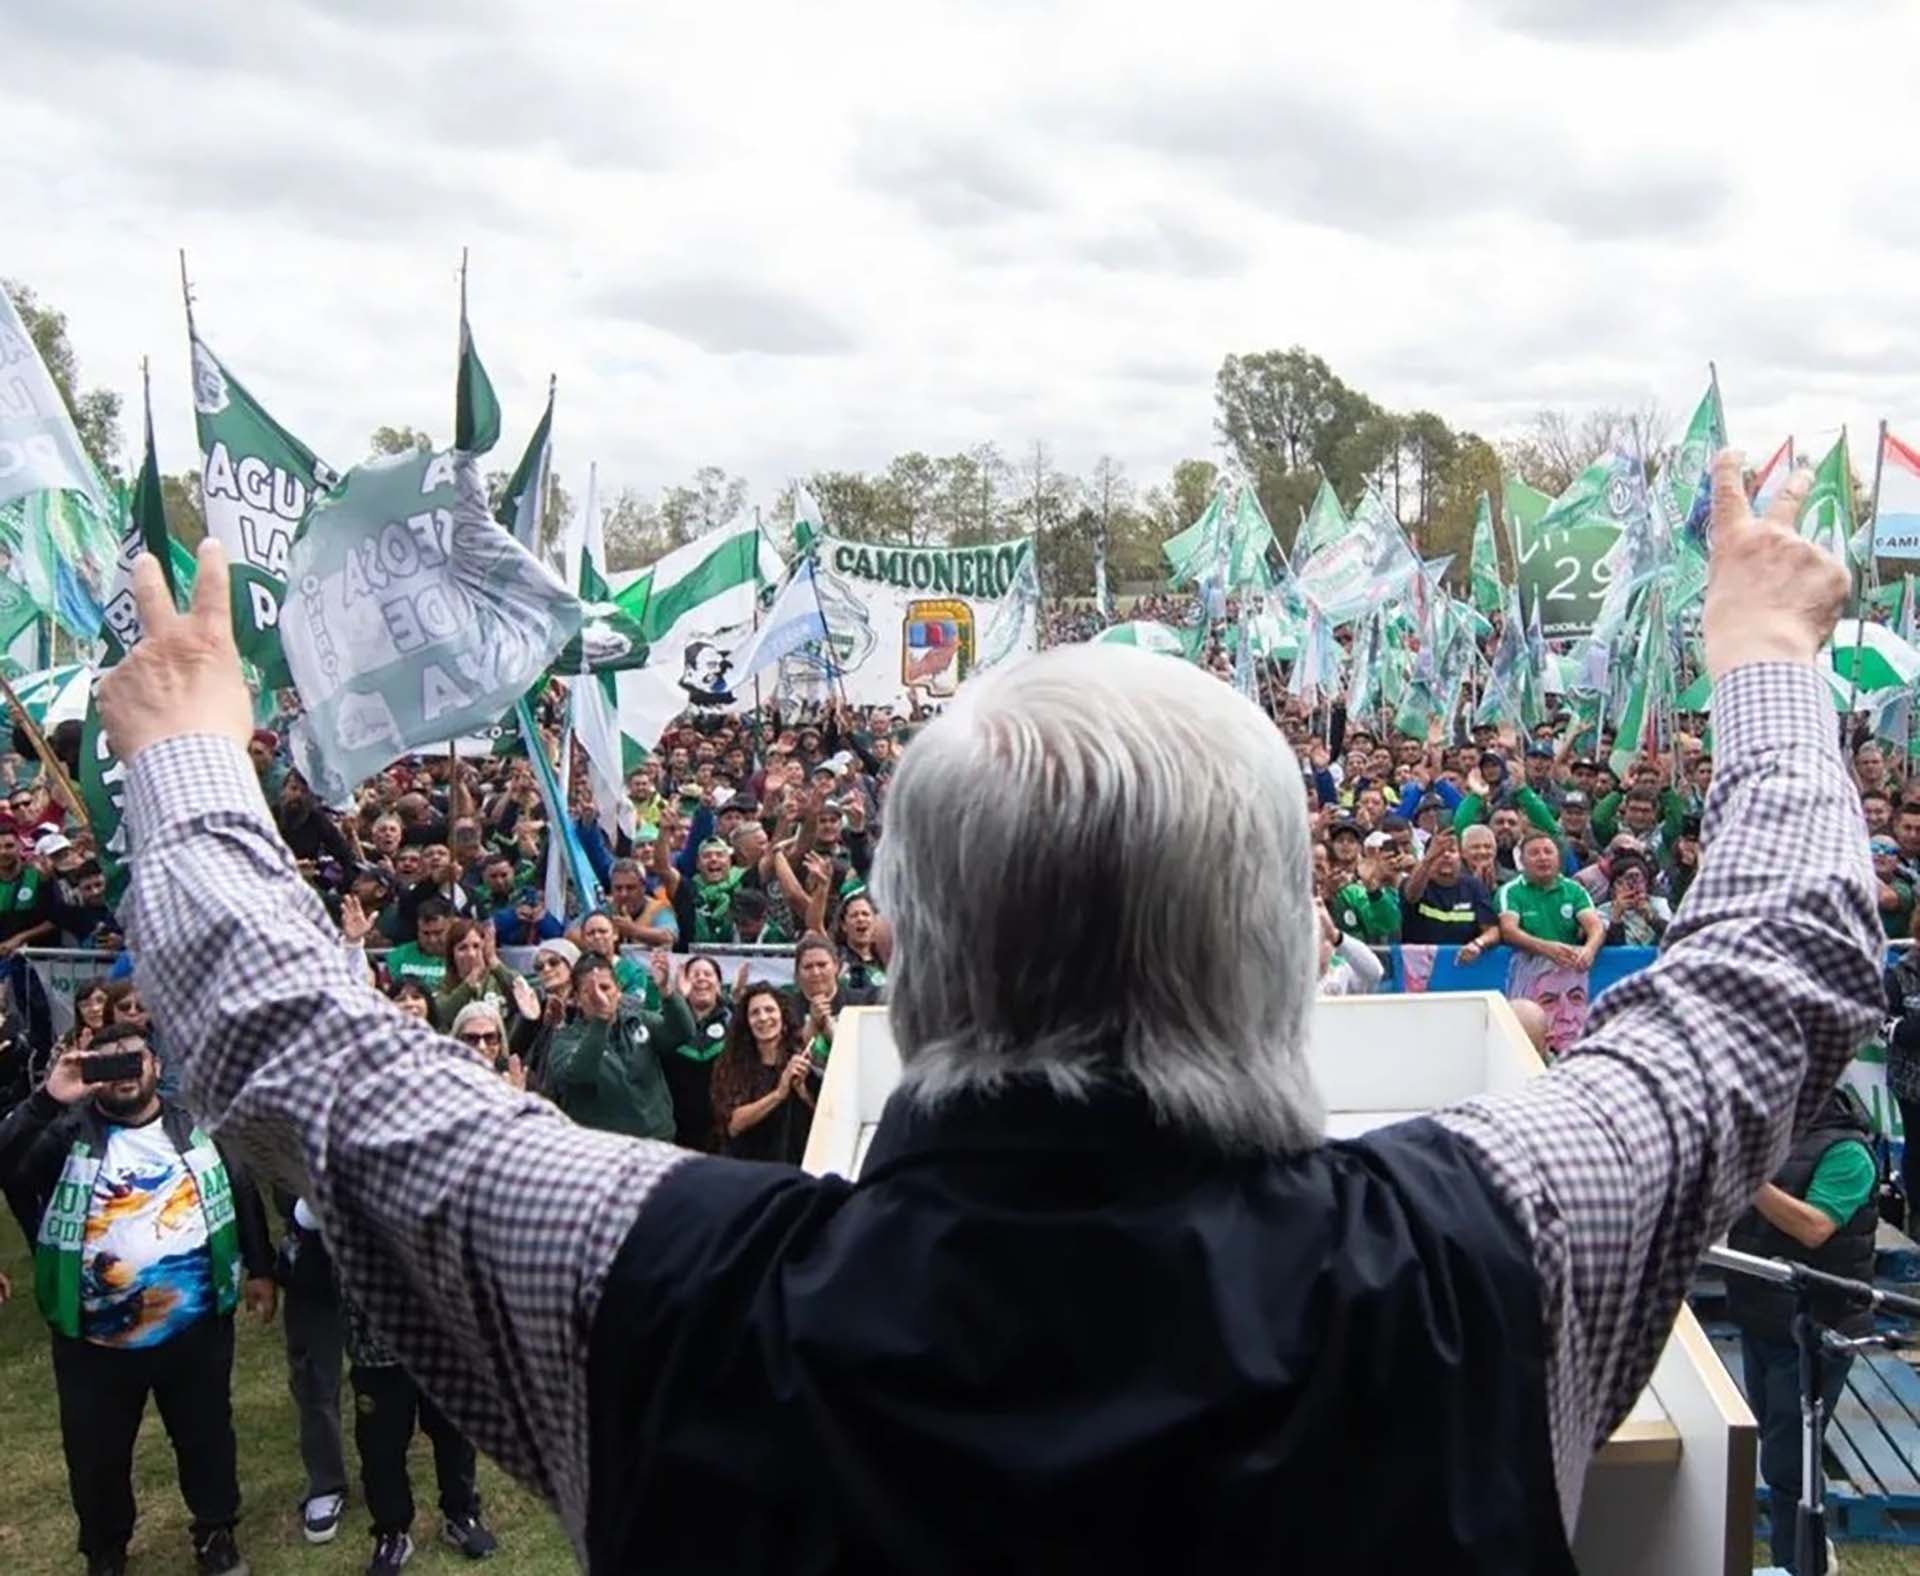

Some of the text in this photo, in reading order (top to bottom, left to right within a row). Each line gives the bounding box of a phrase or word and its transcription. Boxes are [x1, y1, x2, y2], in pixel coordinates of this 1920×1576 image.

[201, 440, 307, 523] AGU
[239, 515, 294, 582] LA
[1875, 536, 1920, 548] CAMI
[247, 580, 279, 631] P
